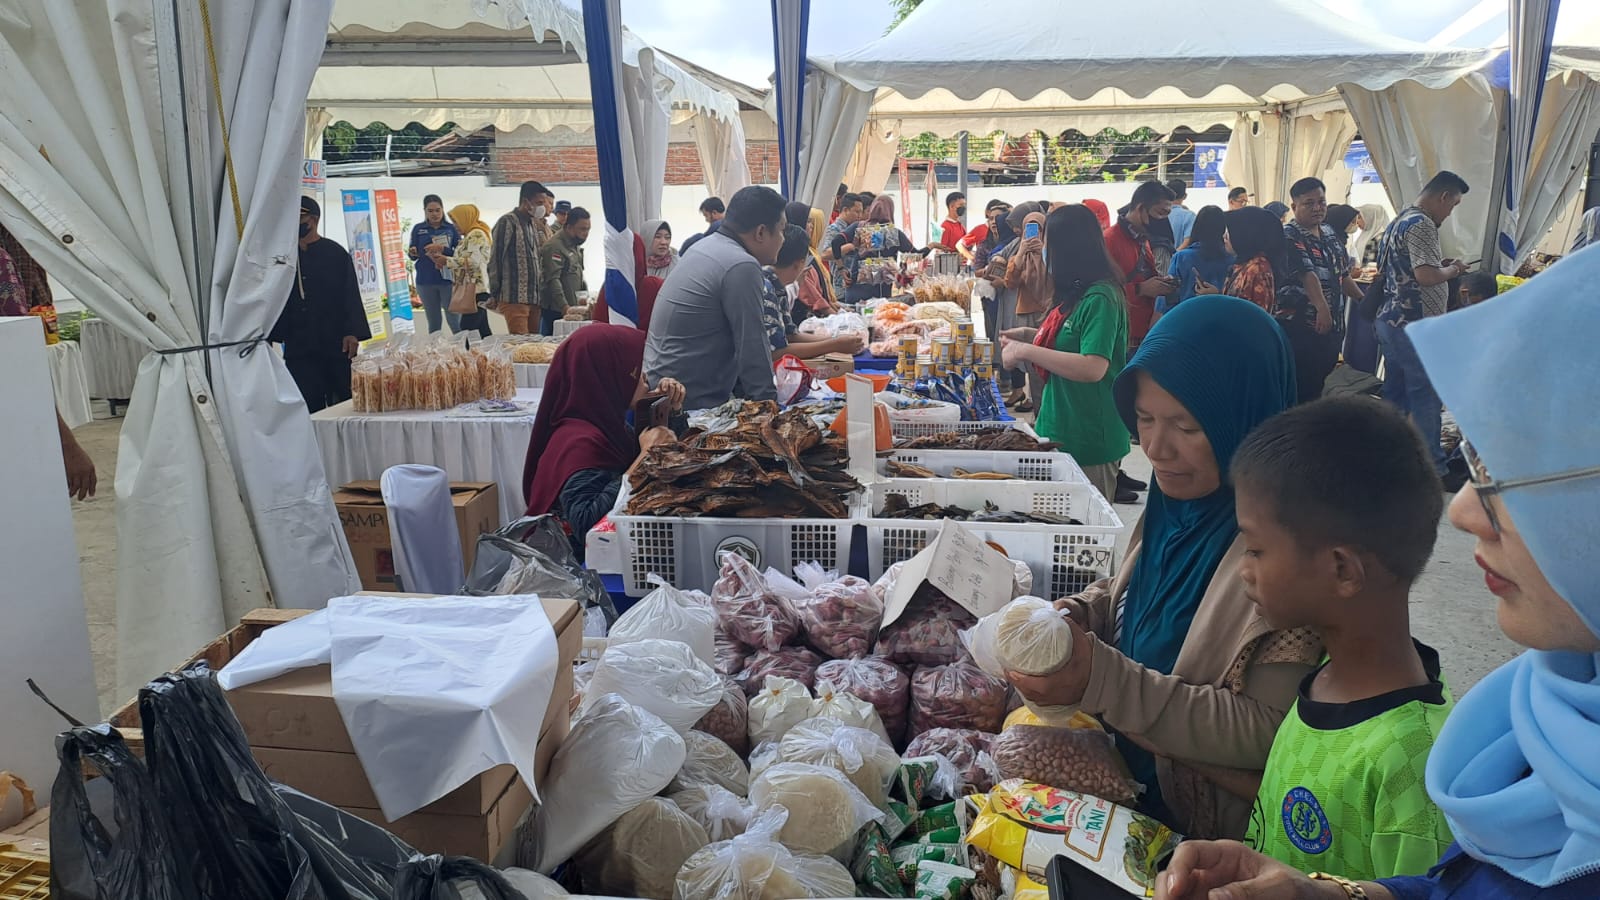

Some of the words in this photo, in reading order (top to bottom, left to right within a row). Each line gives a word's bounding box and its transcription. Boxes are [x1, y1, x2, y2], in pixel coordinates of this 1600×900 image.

[381, 208, 397, 223] KSG
[338, 512, 384, 527] SAMP
[1086, 809, 1106, 830] TANI
